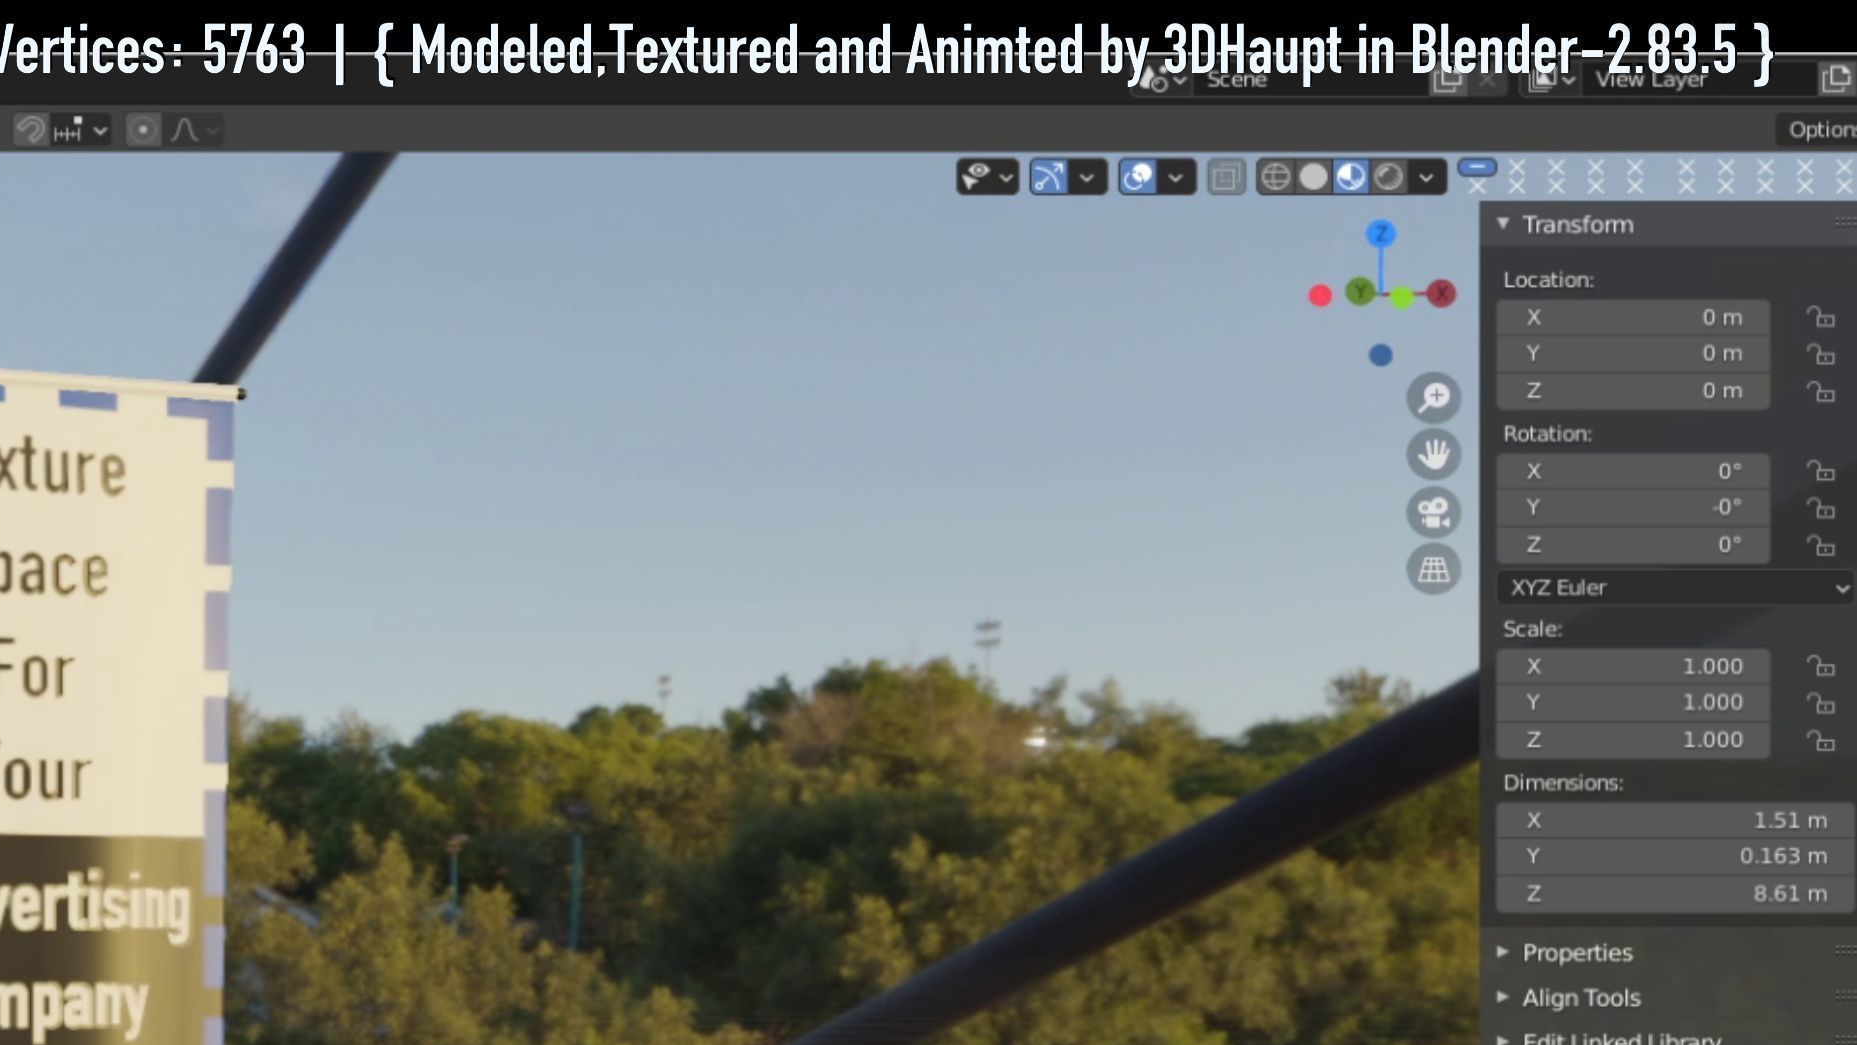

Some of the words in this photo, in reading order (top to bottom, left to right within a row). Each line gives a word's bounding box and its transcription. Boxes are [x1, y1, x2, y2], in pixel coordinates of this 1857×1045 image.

[1207, 71, 1268, 88] Scene
[1596, 71, 1645, 88] View
[1651, 70, 1708, 92] Layer
[1522, 215, 1634, 235] Transform
[1503, 271, 1595, 290] Location:
[1527, 309, 1542, 325] X
[1702, 309, 1716, 325] 0
[1723, 309, 1743, 325] m
[1527, 345, 1542, 361] Y
[1702, 345, 1716, 361] 0
[1723, 345, 1743, 361] m
[1527, 383, 1542, 399] Z
[1702, 383, 1716, 399] 0
[1723, 383, 1743, 399] m
[1503, 425, 1593, 443] Rotation:
[1527, 463, 1542, 479] X
[1718, 463, 1742, 479] 0°
[1527, 499, 1542, 516] Y
[1527, 537, 1542, 553] Z
[1718, 537, 1742, 553] 0°
[1511, 579, 1552, 597] XYZ
[1556, 579, 1608, 597] Euler
[1503, 620, 1563, 639] Scale:
[1527, 658, 1542, 675] X
[1683, 658, 1744, 675] 1.000
[1527, 693, 1542, 711] Y
[1683, 693, 1744, 711] 1.000
[1527, 731, 1542, 748] Z
[1683, 731, 1744, 748] 1.000
[1503, 774, 1624, 792] Dimensions:
[1527, 812, 1542, 829] X
[1753, 812, 1801, 829] 1.51
[1807, 812, 1828, 829] m
[1527, 847, 1542, 864] Y
[1740, 847, 1801, 864] 0.163
[1807, 847, 1828, 864] m
[1527, 885, 1542, 902] Z
[1753, 885, 1801, 902] 8.61
[1807, 885, 1828, 902] m
[1522, 943, 1634, 966] Properties
[1522, 988, 1579, 1010] Align
[1584, 988, 1642, 1007] Tools
